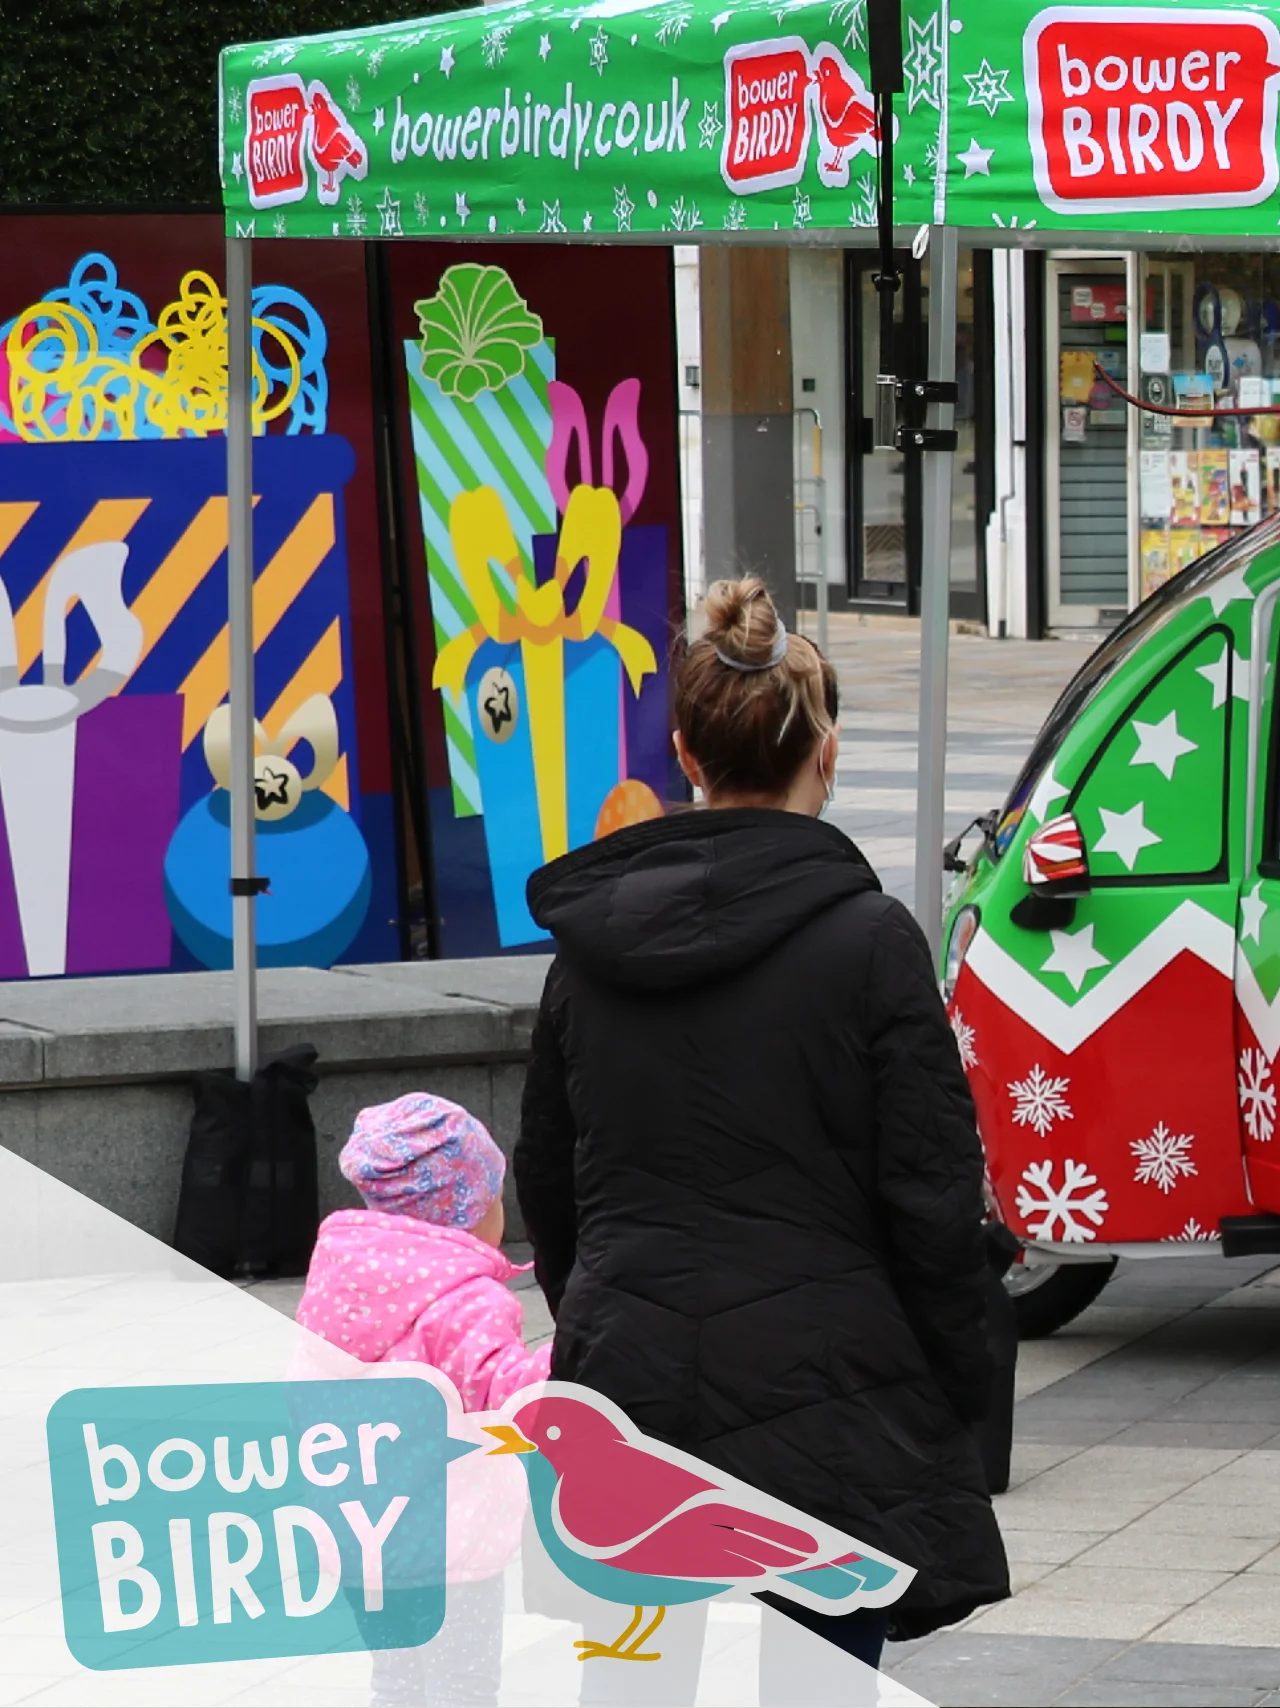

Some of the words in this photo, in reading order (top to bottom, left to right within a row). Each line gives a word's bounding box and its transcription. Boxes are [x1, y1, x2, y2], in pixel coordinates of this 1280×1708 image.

[737, 66, 799, 107] bower
[1057, 43, 1242, 97] bower
[252, 102, 299, 131] bower
[389, 77, 689, 162] bowerbirdy.co.uk
[736, 102, 799, 162] BIRDY
[1062, 98, 1243, 177] BIRDY
[251, 136, 299, 181] BIRDY
